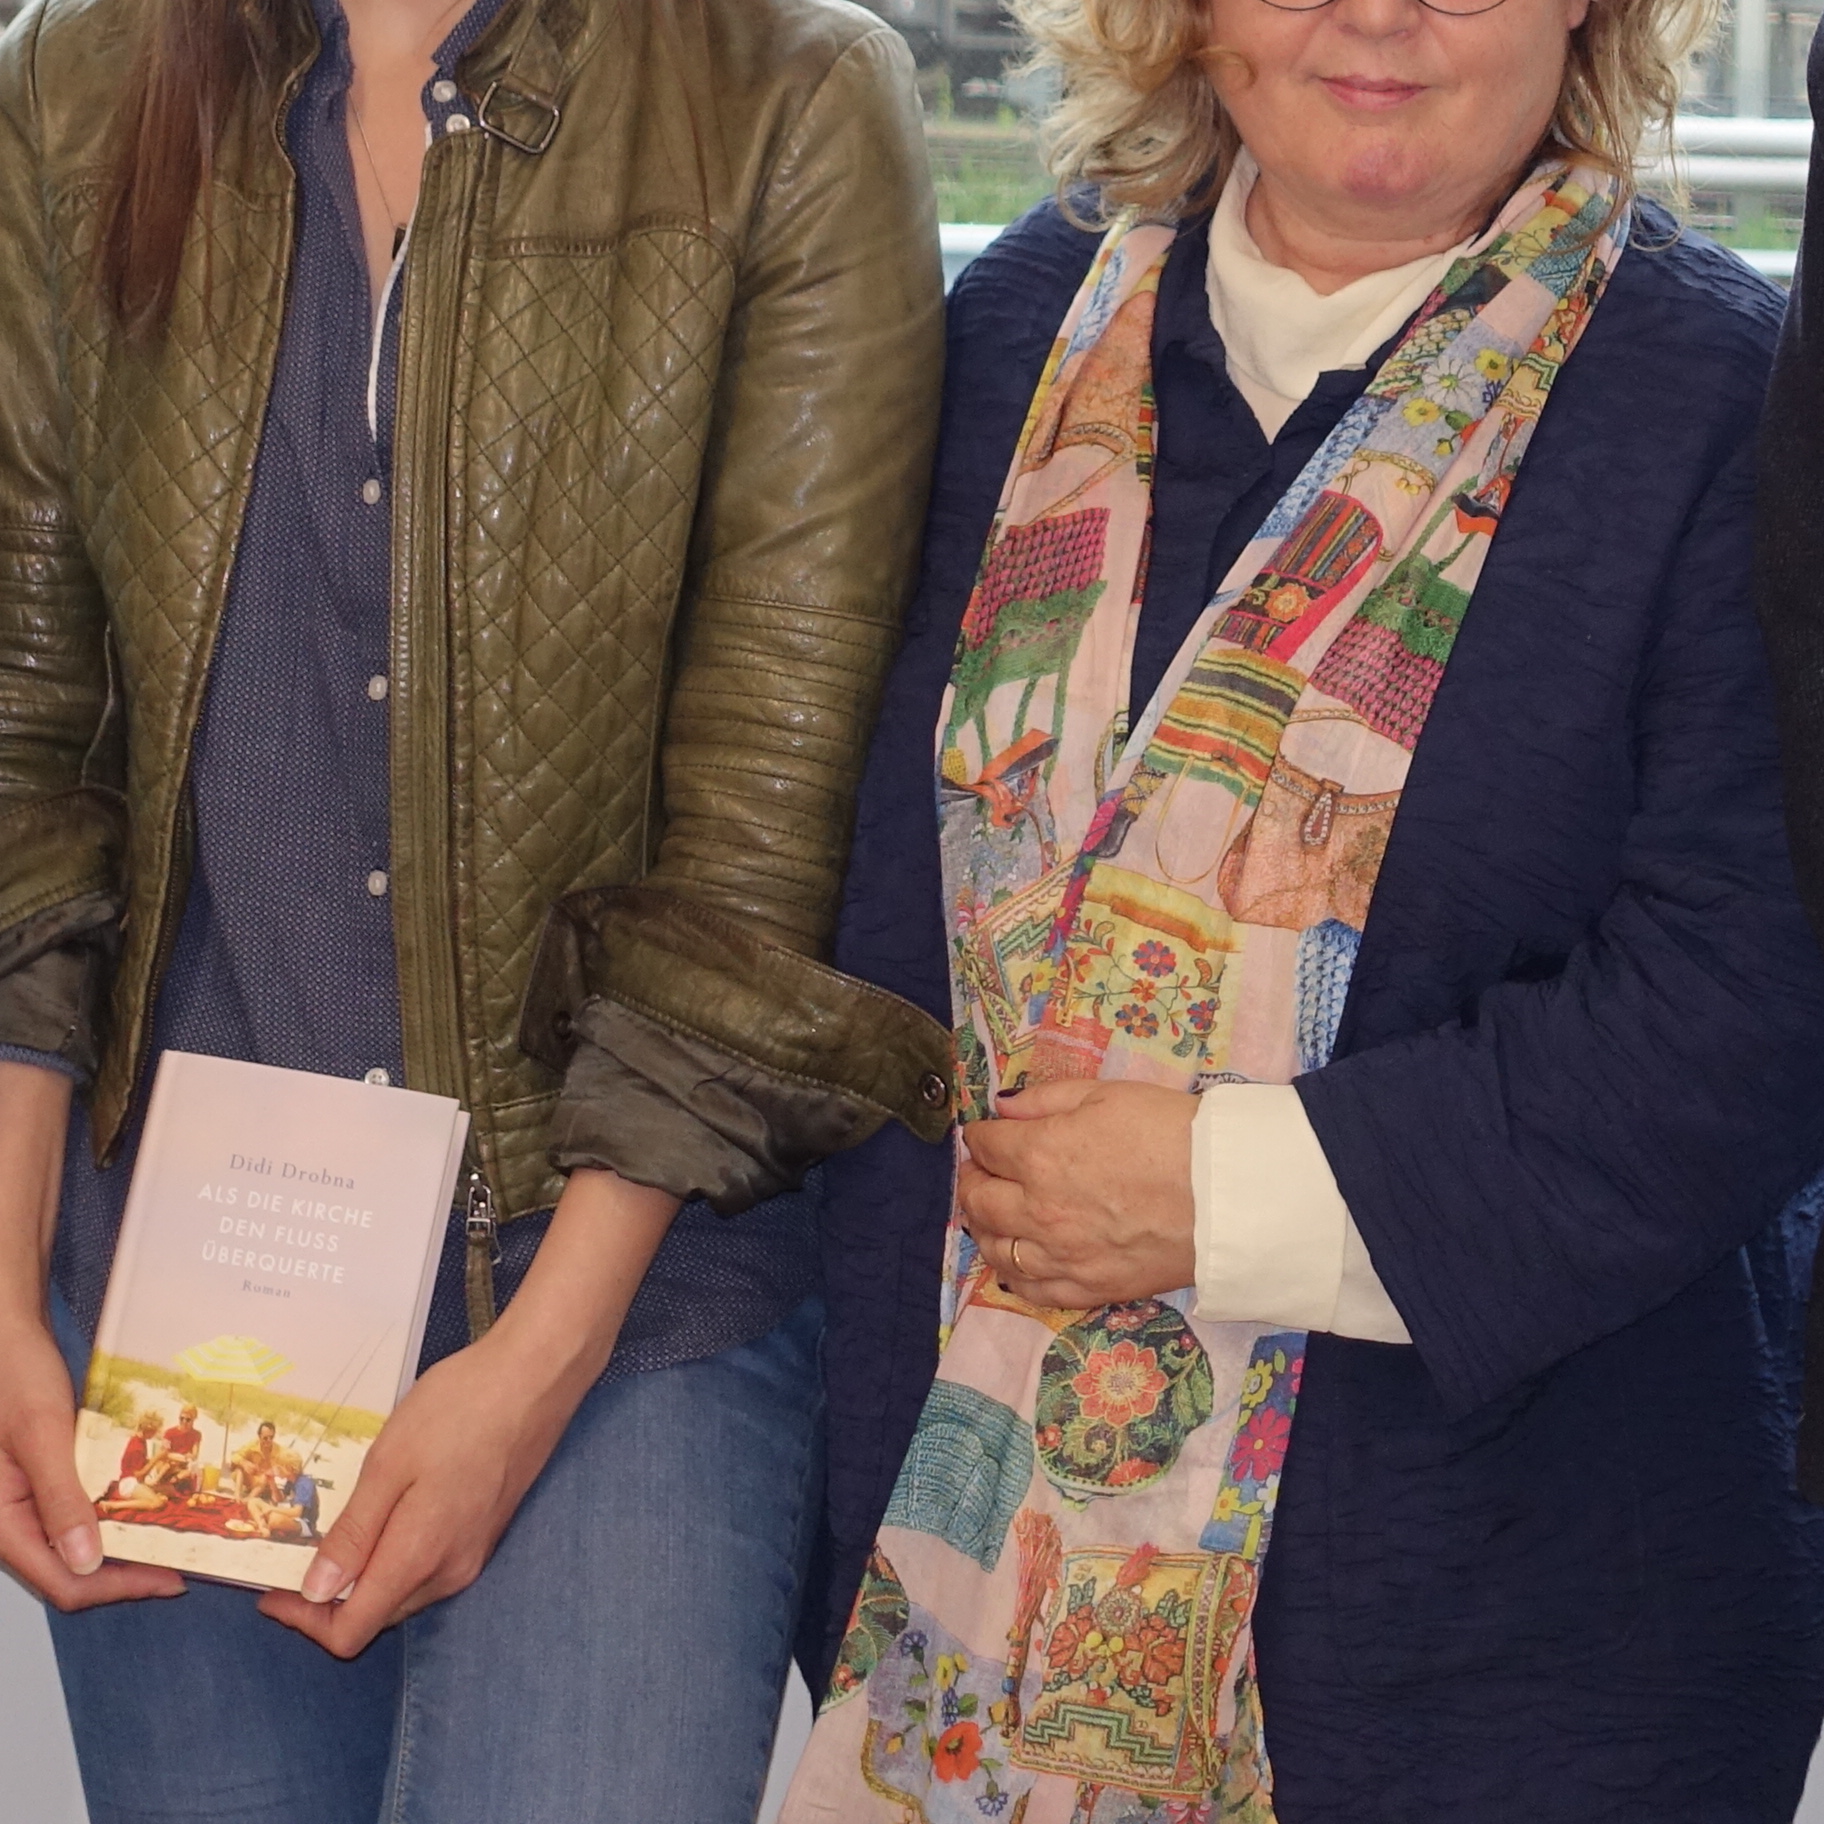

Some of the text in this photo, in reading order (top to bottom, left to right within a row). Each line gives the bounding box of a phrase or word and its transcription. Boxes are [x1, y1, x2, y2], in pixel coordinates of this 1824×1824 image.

[229, 1153, 356, 1190] Didi Drobna
[197, 1182, 374, 1228] ALS DIE KIRCHE
[219, 1215, 339, 1253] DEN FLUSS
[201, 1238, 345, 1285] ÜBERQUERTE
[241, 1278, 292, 1299] Roman
